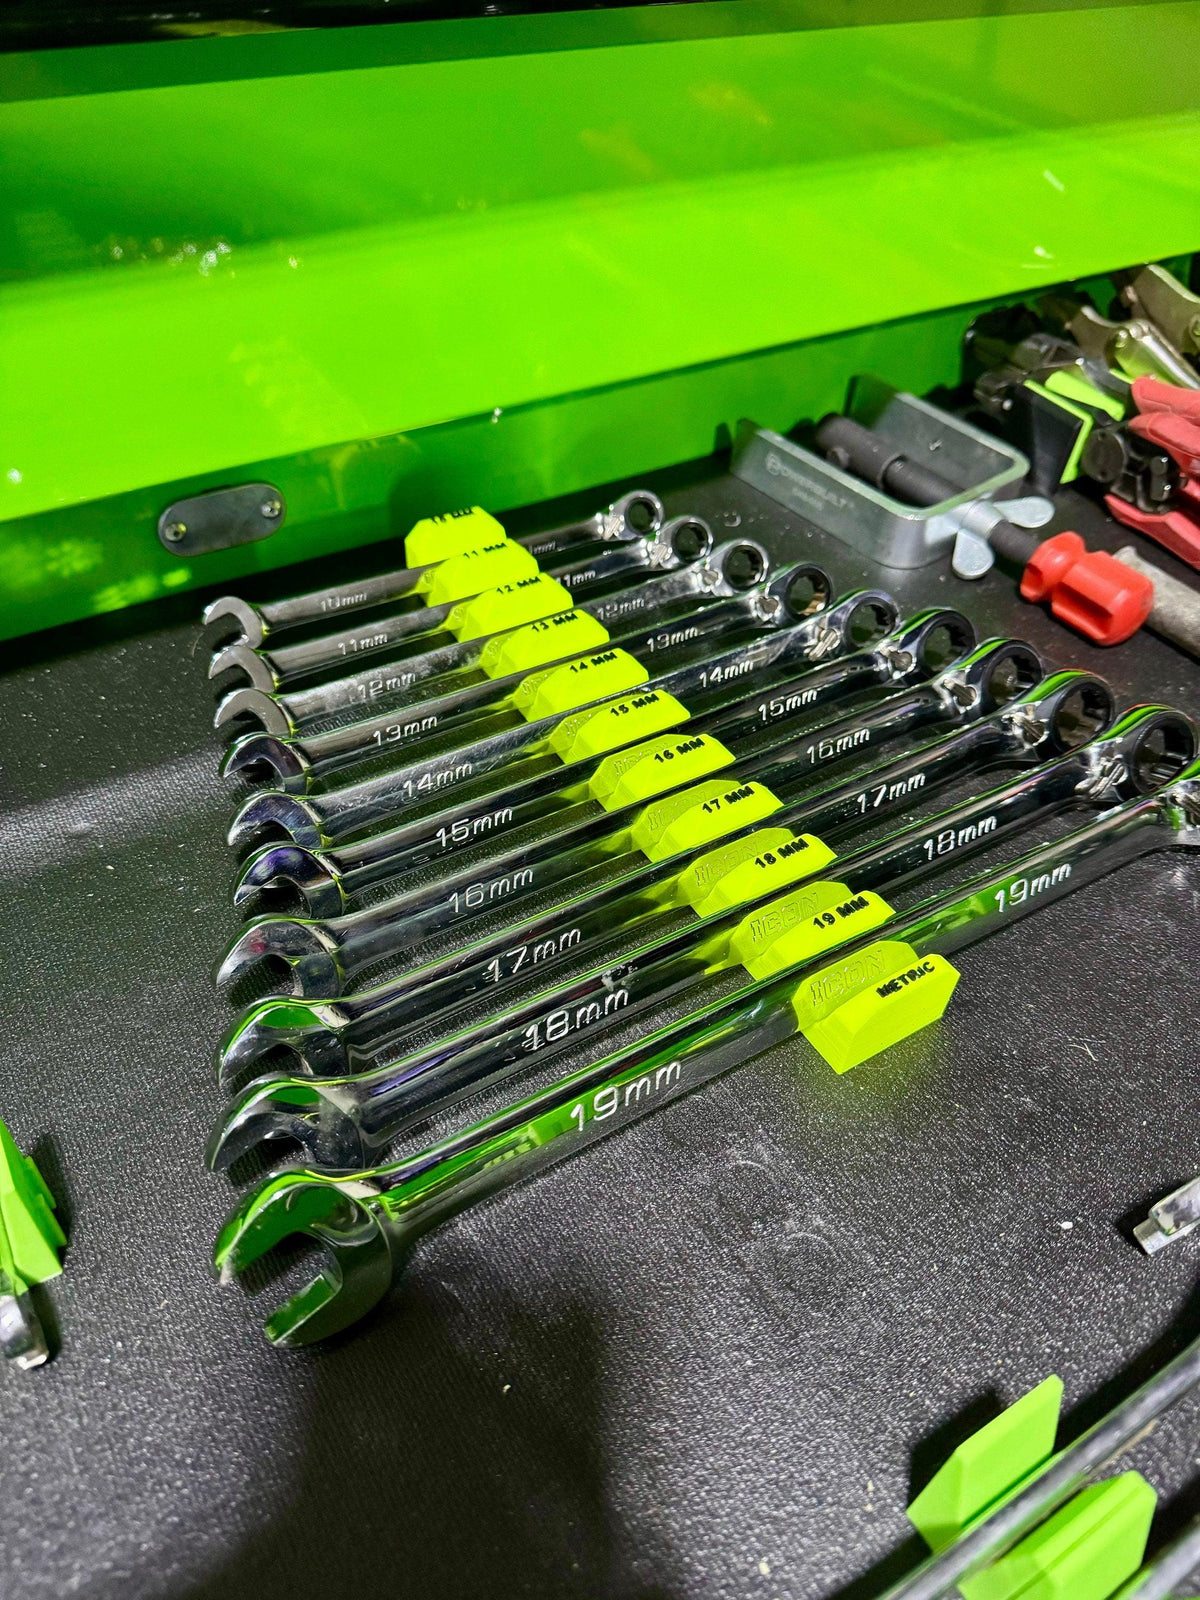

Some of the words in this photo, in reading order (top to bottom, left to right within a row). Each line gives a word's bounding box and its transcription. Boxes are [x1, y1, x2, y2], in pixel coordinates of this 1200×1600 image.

[463, 550, 478, 560] 11
[484, 542, 507, 553] MM
[496, 584, 514, 595] 12
[519, 576, 543, 588] MM
[531, 621, 550, 633] 13
[552, 612, 579, 626] MM
[337, 633, 388, 656] 11mm
[646, 626, 698, 653] 13mm
[568, 660, 589, 674] 14
[591, 651, 619, 667] MM
[699, 660, 754, 688] 14mm
[358, 672, 417, 700] 12mm
[610, 703, 629, 717] 15
[632, 691, 660, 709] MM
[758, 689, 818, 721] 15mm
[372, 715, 438, 747] 13mm
[806, 727, 870, 765] 16mm
[654, 749, 676, 764] 16
[676, 736, 706, 754] MM
[403, 761, 473, 798] 14mm
[857, 772, 926, 815] 17mm
[701, 798, 721, 814] 17
[724, 785, 755, 805] MM
[436, 806, 513, 848] 15mm
[923, 815, 997, 861] 18mm
[755, 852, 778, 870] 18
[777, 837, 810, 860] MM
[449, 866, 534, 914] 16mm
[994, 862, 1072, 913] 19mm
[812, 911, 836, 930] 19
[836, 895, 870, 919] MM
[488, 927, 582, 983] 17mm
[810, 948, 888, 1007] ICON
[875, 960, 937, 999] METRIC
[525, 988, 629, 1052] 18mm
[570, 1061, 682, 1132] 19mm
